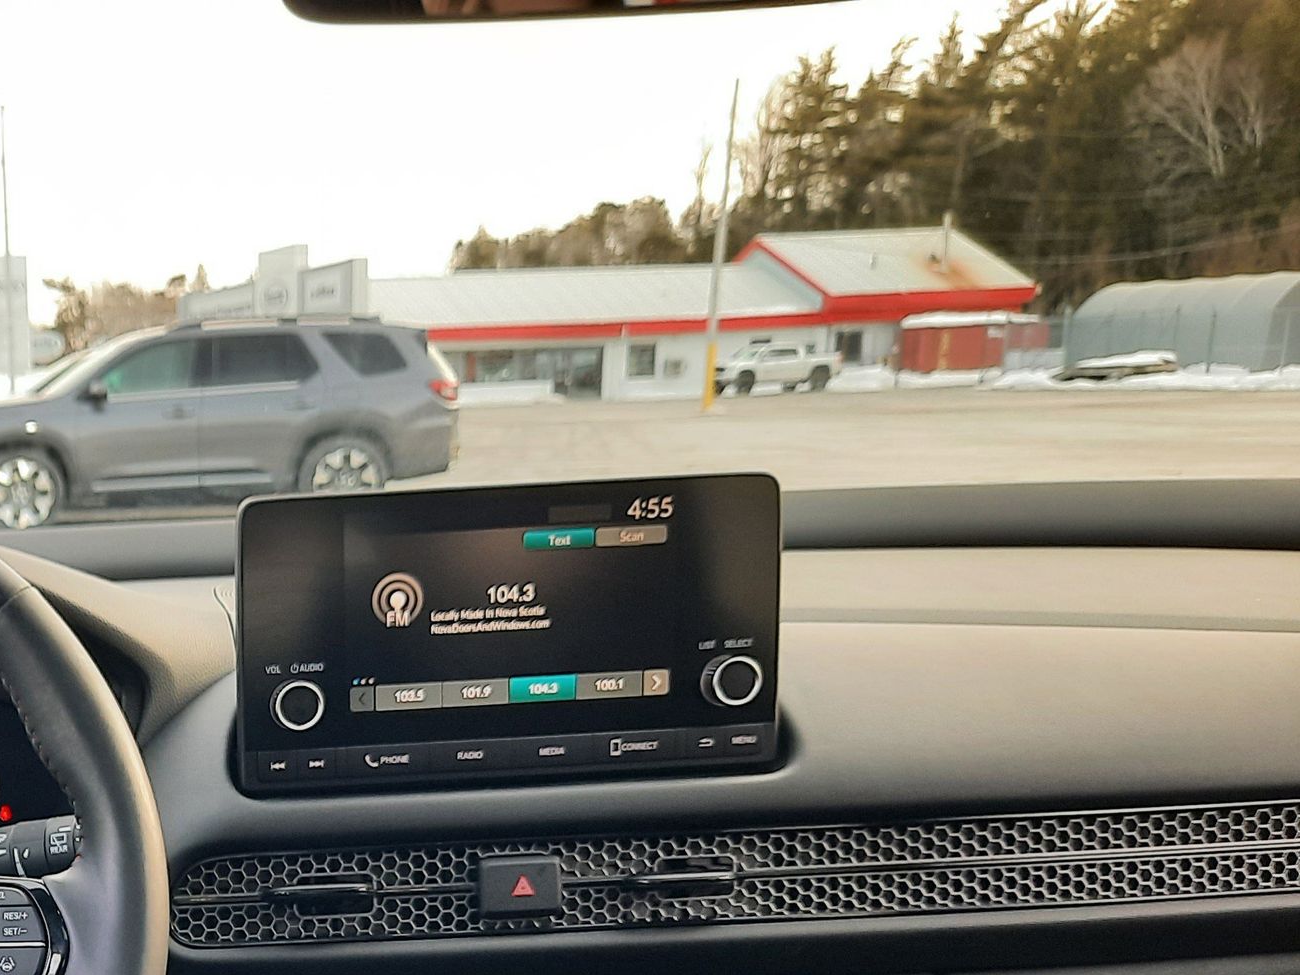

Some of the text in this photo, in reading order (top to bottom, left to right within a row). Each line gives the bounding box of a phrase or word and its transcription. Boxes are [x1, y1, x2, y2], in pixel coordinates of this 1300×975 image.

[627, 496, 674, 519] 4:55
[548, 534, 571, 547] Text
[619, 531, 645, 543] Scan
[487, 583, 536, 603] 104.3
[460, 608, 484, 620] Made
[496, 605, 518, 617] Nova
[518, 604, 547, 617] Scotia
[386, 610, 411, 628] FM
[724, 638, 753, 649] SELECT
[265, 663, 324, 675] VOL AUDIO
[528, 681, 558, 695] 104.3
[594, 677, 624, 692] 100.1
[462, 685, 493, 699] 101.9
[538, 746, 565, 757] MEDIA
[620, 740, 659, 752] CONNECT
[380, 753, 410, 765] PHONE
[457, 750, 484, 761] RADIO
[50, 845, 68, 855] REAR
[3, 911, 28, 920] RES/+
